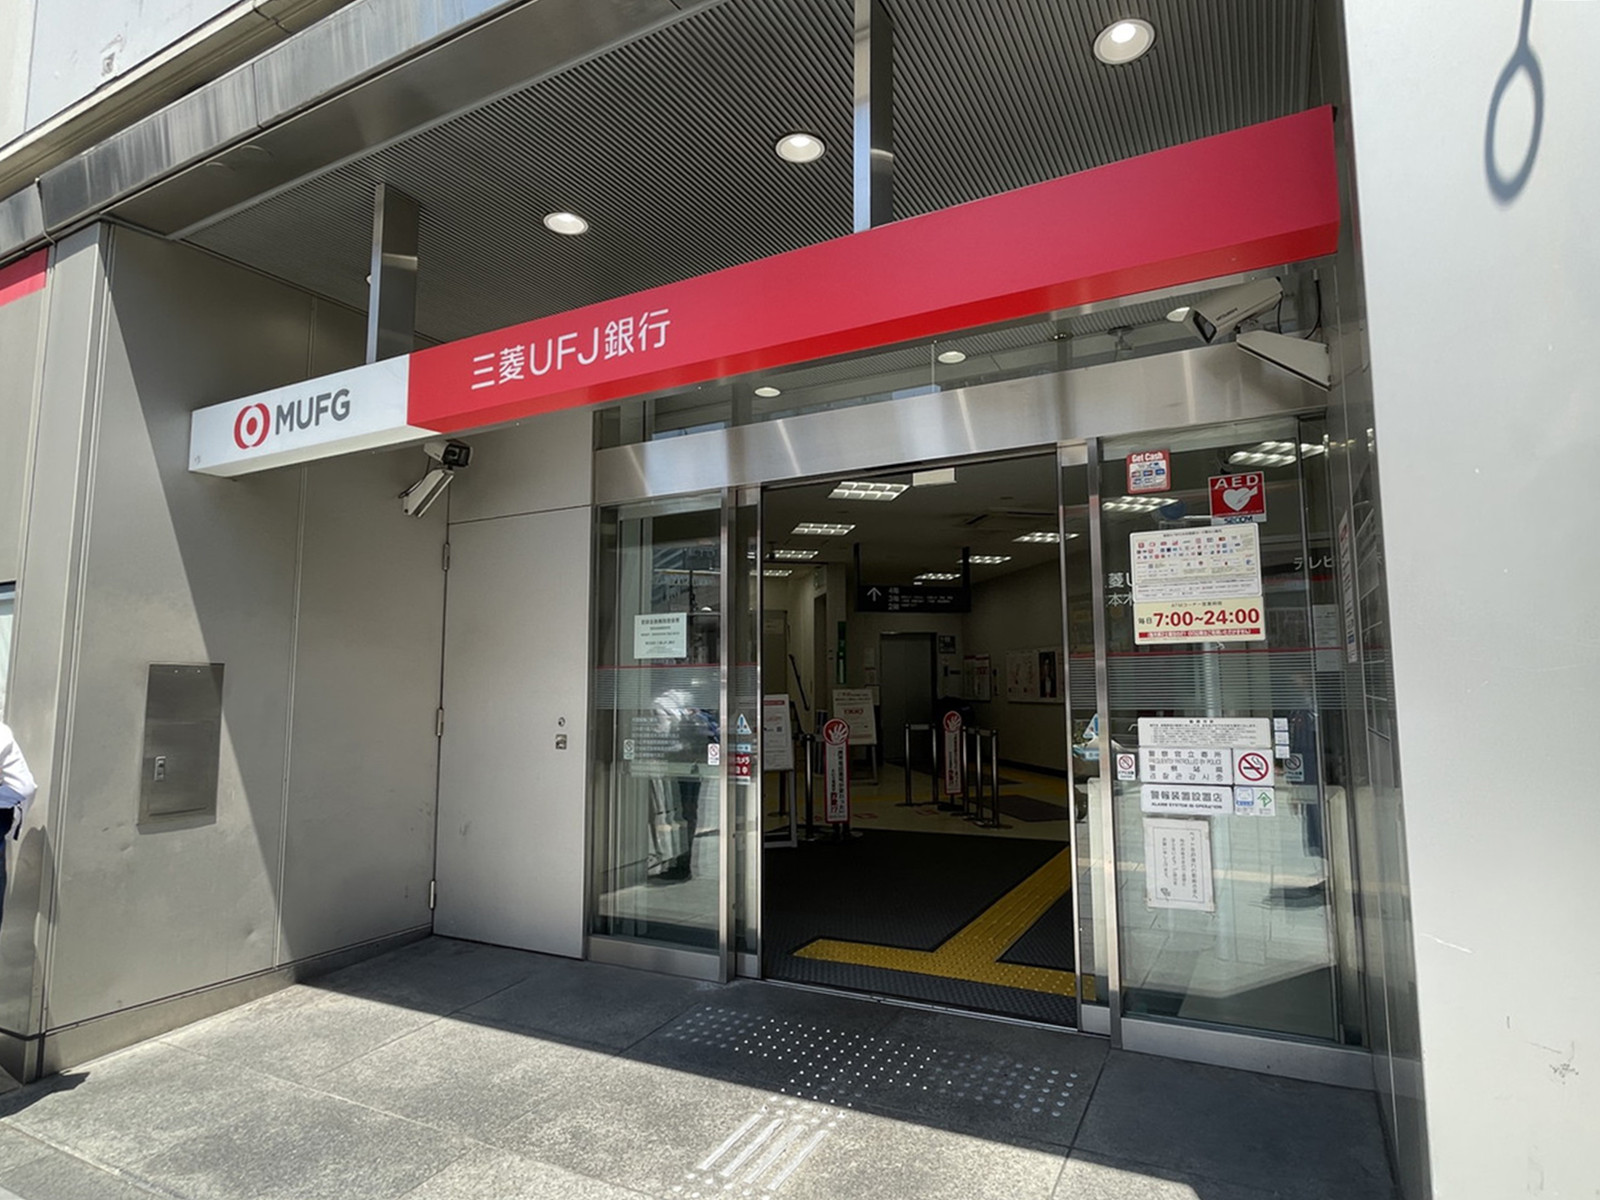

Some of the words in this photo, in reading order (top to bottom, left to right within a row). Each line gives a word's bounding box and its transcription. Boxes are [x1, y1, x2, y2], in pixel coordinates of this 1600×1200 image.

[470, 308, 671, 391] 三菱UFJ銀行
[274, 387, 351, 436] MUFG
[1131, 454, 1145, 463] Get
[1145, 451, 1164, 462] Cash
[1214, 474, 1260, 490] AED
[1223, 515, 1254, 524] SECOM
[1150, 790, 1223, 803] 警報装置設置店
